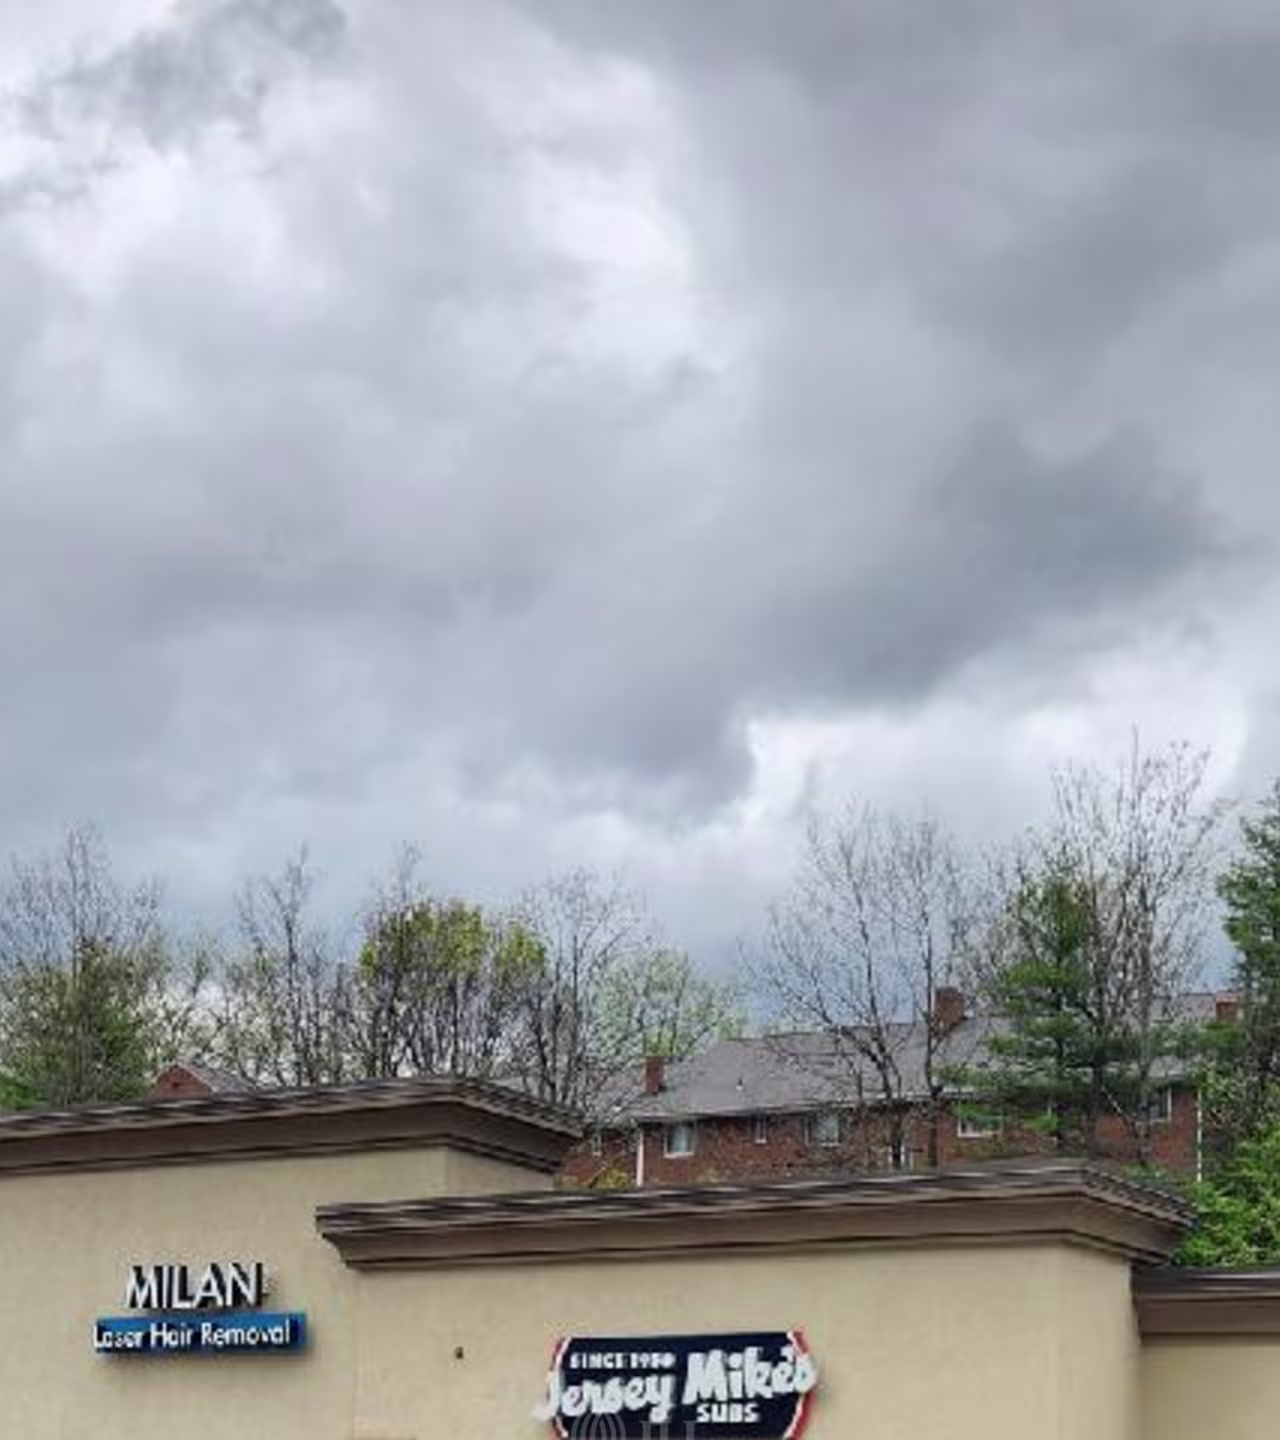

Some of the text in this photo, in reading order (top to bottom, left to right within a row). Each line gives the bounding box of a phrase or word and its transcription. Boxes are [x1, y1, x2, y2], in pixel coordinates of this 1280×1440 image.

[125, 1262, 260, 1309] MILAN
[93, 1317, 291, 1349] Laser Hair Removal
[570, 1352, 624, 1369] SINCE
[530, 1345, 818, 1424] Jersey Mike's
[696, 1403, 761, 1423] SUBS
